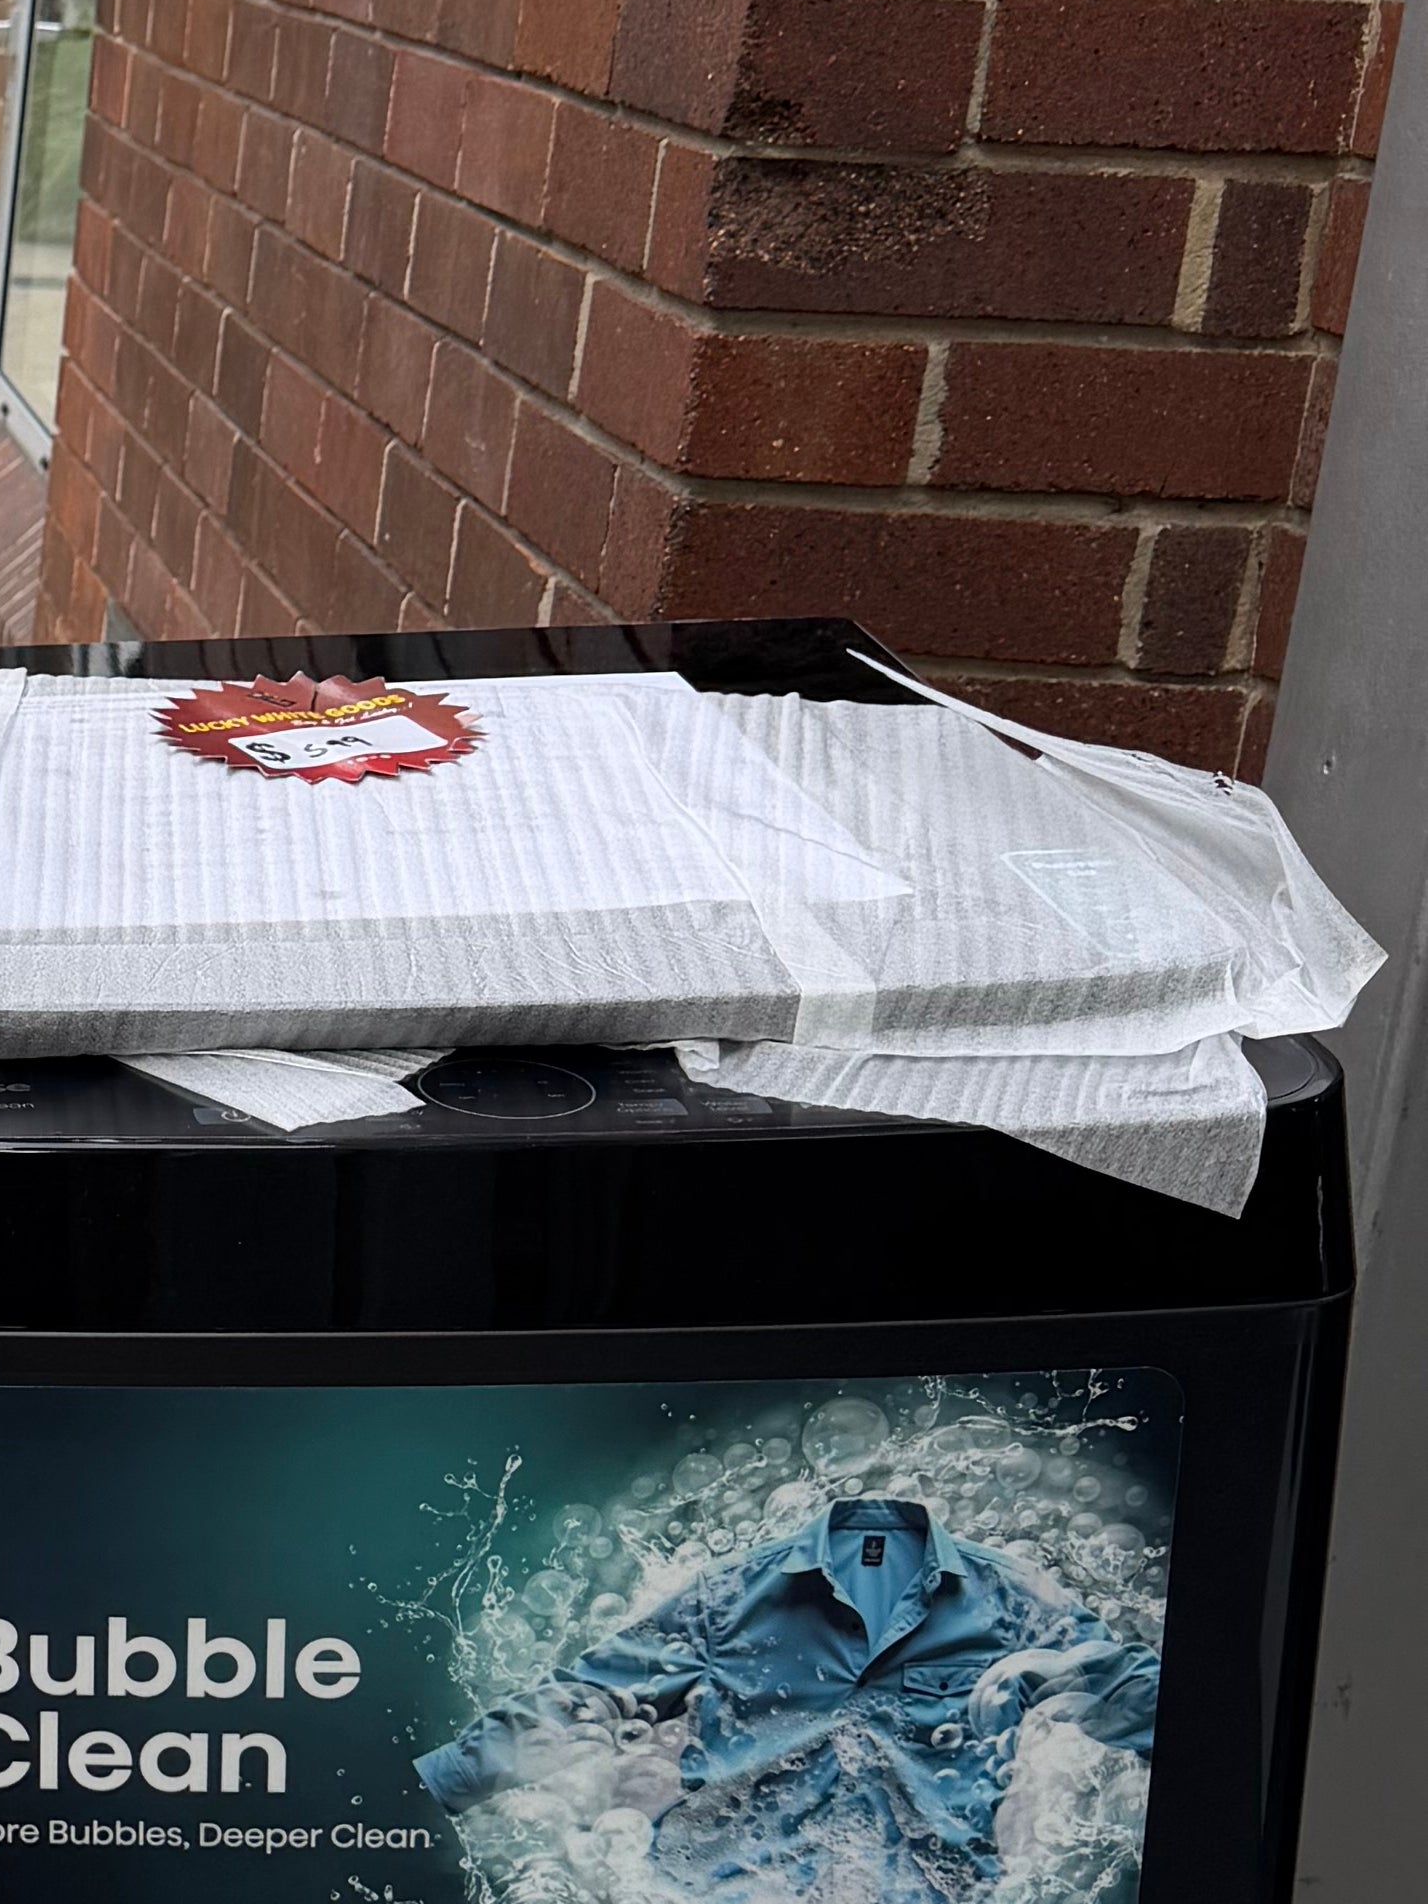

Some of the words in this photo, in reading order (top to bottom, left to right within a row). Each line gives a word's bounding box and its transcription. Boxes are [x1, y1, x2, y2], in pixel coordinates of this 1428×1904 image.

[178, 716, 250, 734] LUCKY
[251, 710, 326, 724] WHITE
[325, 694, 407, 718] GOODS
[49, 1819, 191, 1851] Bubbles,
[199, 1821, 323, 1855] Deeper
